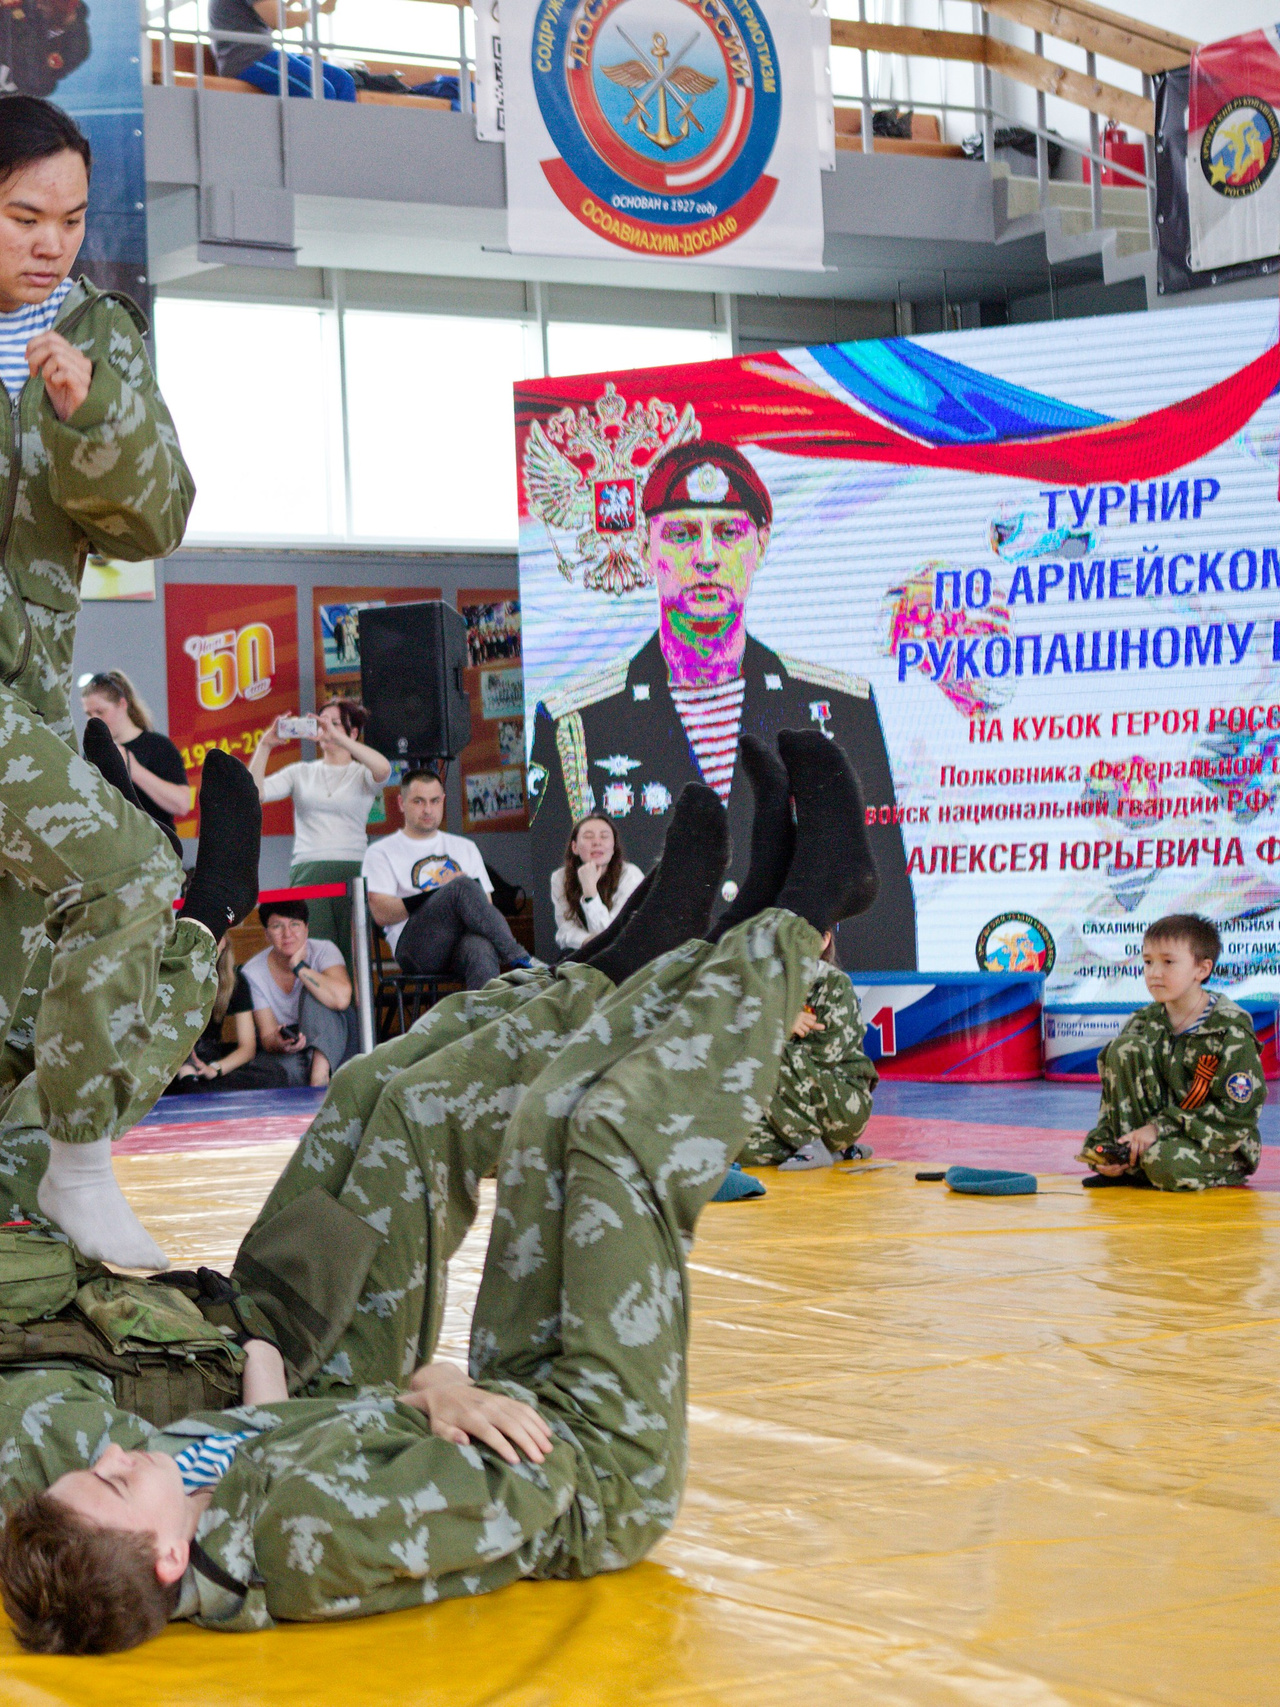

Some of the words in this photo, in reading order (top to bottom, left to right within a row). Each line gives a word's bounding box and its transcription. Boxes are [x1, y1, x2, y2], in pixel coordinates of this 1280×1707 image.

[570, 0, 608, 66] ДОС
[694, 0, 751, 79] ССИИ
[581, 198, 738, 256] ОСОАВИАХИМ-ДОСААФ
[611, 194, 662, 211] ОСНОВАН
[670, 199, 696, 213] 1927
[696, 203, 718, 218] году
[1039, 478, 1221, 530] ТУРНИР
[933, 567, 993, 611] ПО
[197, 622, 276, 710] 50
[898, 621, 1257, 683] РУКОПАШНОМУ
[969, 717, 1004, 744] НА
[1013, 711, 1102, 742] КУБОК
[1112, 708, 1200, 737] ГЕРОЯ
[940, 763, 1081, 788] Полковника
[1090, 752, 1263, 784] Федеральной
[865, 802, 931, 826] войск
[938, 797, 1109, 825] национальной
[1116, 795, 1219, 820] гвардии
[904, 842, 1049, 876] АЛЕКСЕЯ
[1059, 837, 1245, 873] ЮРЬЕВИЧА
[870, 1006, 897, 1056] 1
